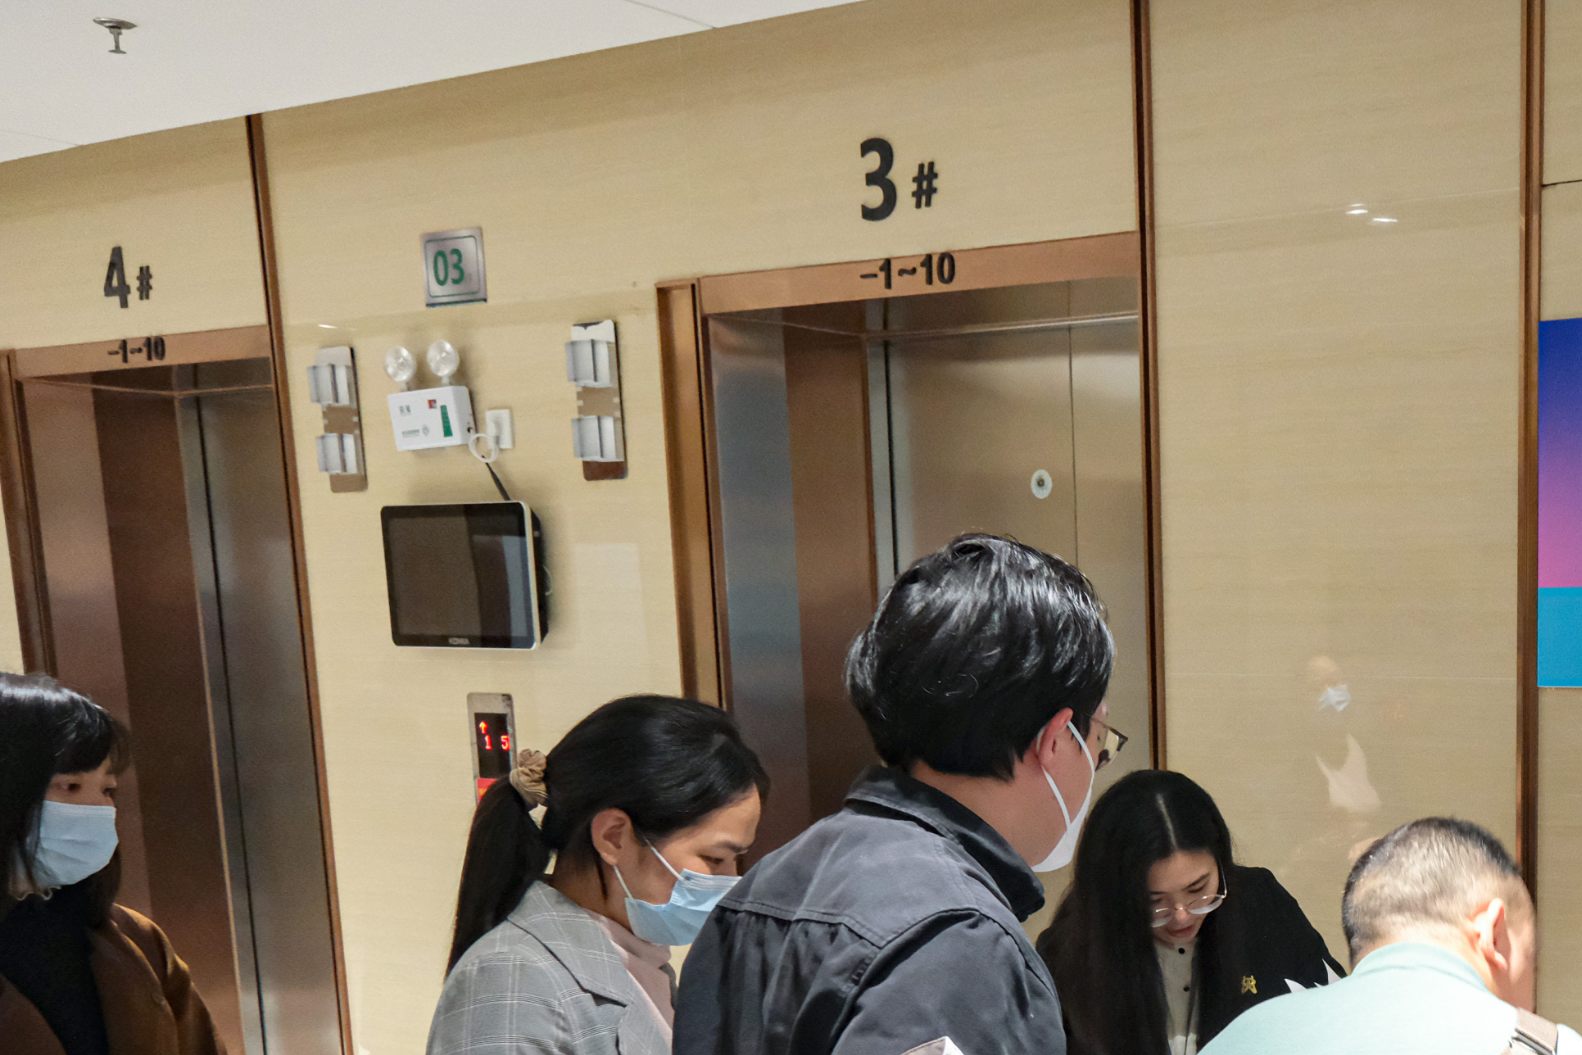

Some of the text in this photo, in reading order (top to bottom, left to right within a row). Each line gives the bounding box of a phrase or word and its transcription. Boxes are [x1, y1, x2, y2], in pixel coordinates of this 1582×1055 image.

[859, 137, 939, 222] 3#
[103, 245, 153, 309] 4#
[433, 248, 465, 286] 03
